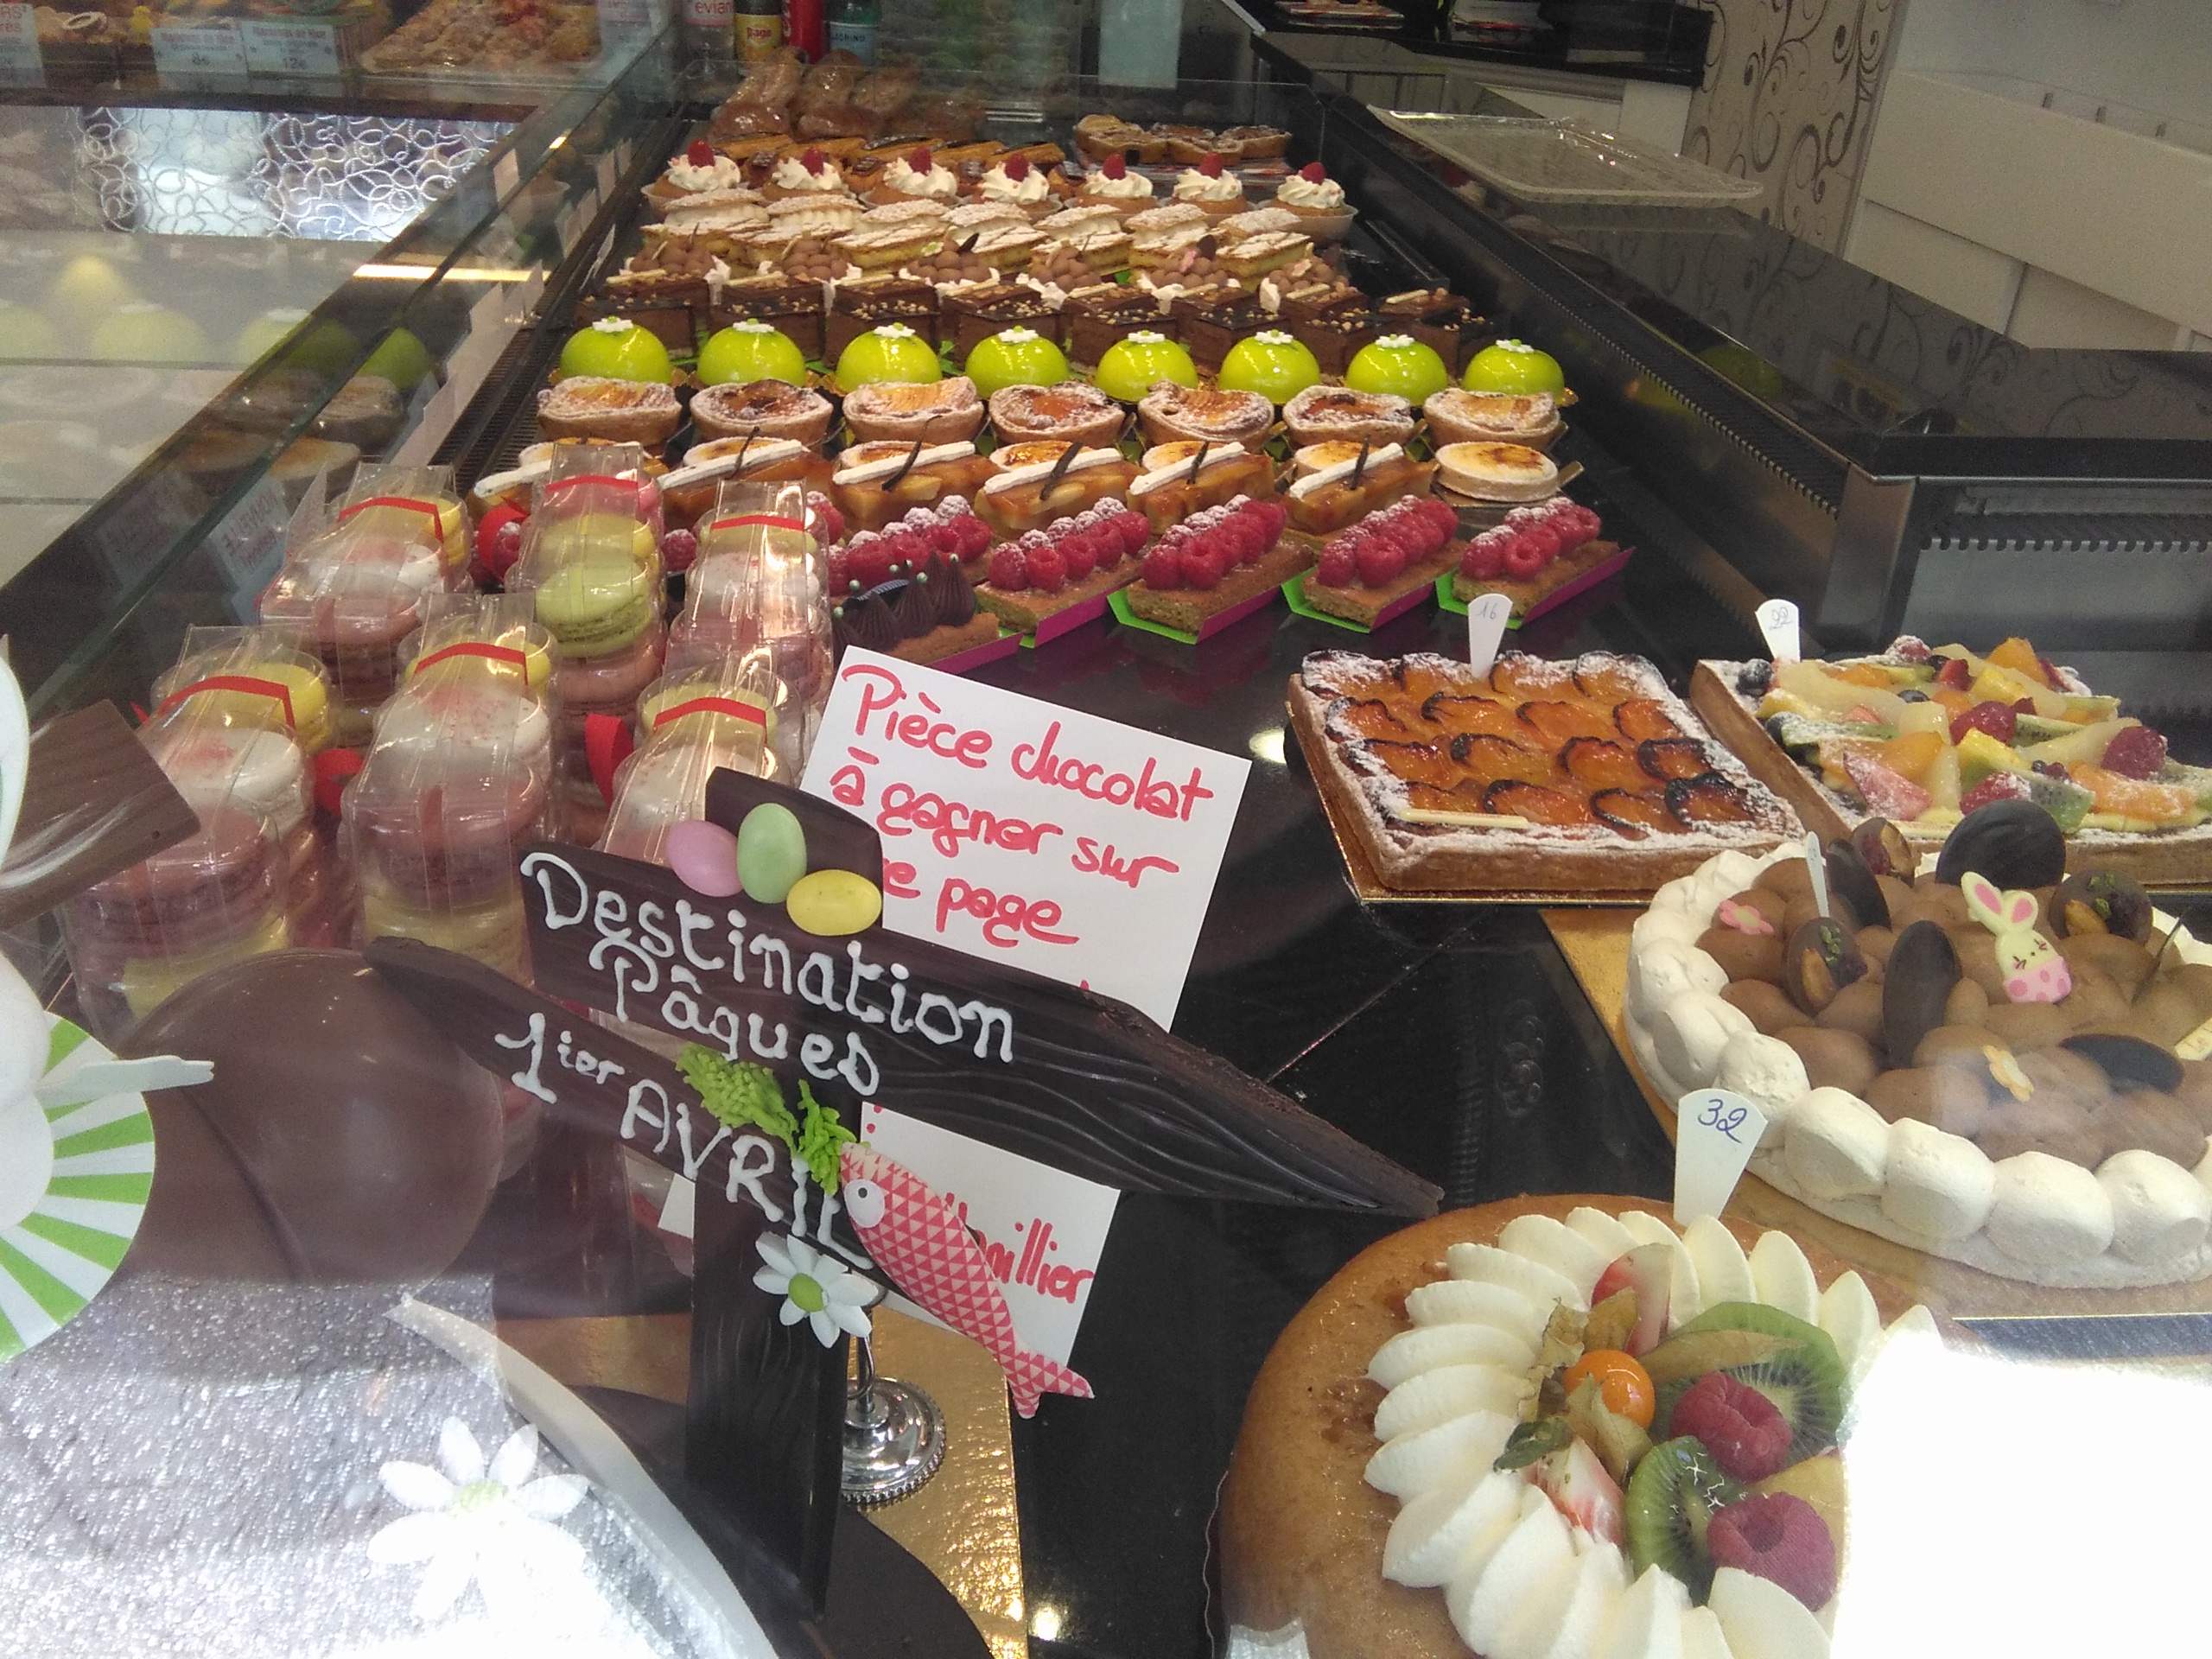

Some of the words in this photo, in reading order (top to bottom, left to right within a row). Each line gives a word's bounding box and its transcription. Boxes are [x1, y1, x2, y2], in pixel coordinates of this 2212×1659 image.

[1476, 601, 1497, 620] 16
[842, 664, 993, 768] Pièce
[1011, 721, 1215, 822] chocolat
[877, 782, 1064, 858] gagner
[1071, 836, 1180, 889] sur
[520, 852, 1014, 1064] Destination
[935, 877, 1080, 948] page
[588, 928, 880, 1096] Pâques
[620, 1078, 874, 1270] AVRIL
[1697, 1098, 1747, 1144] 32
